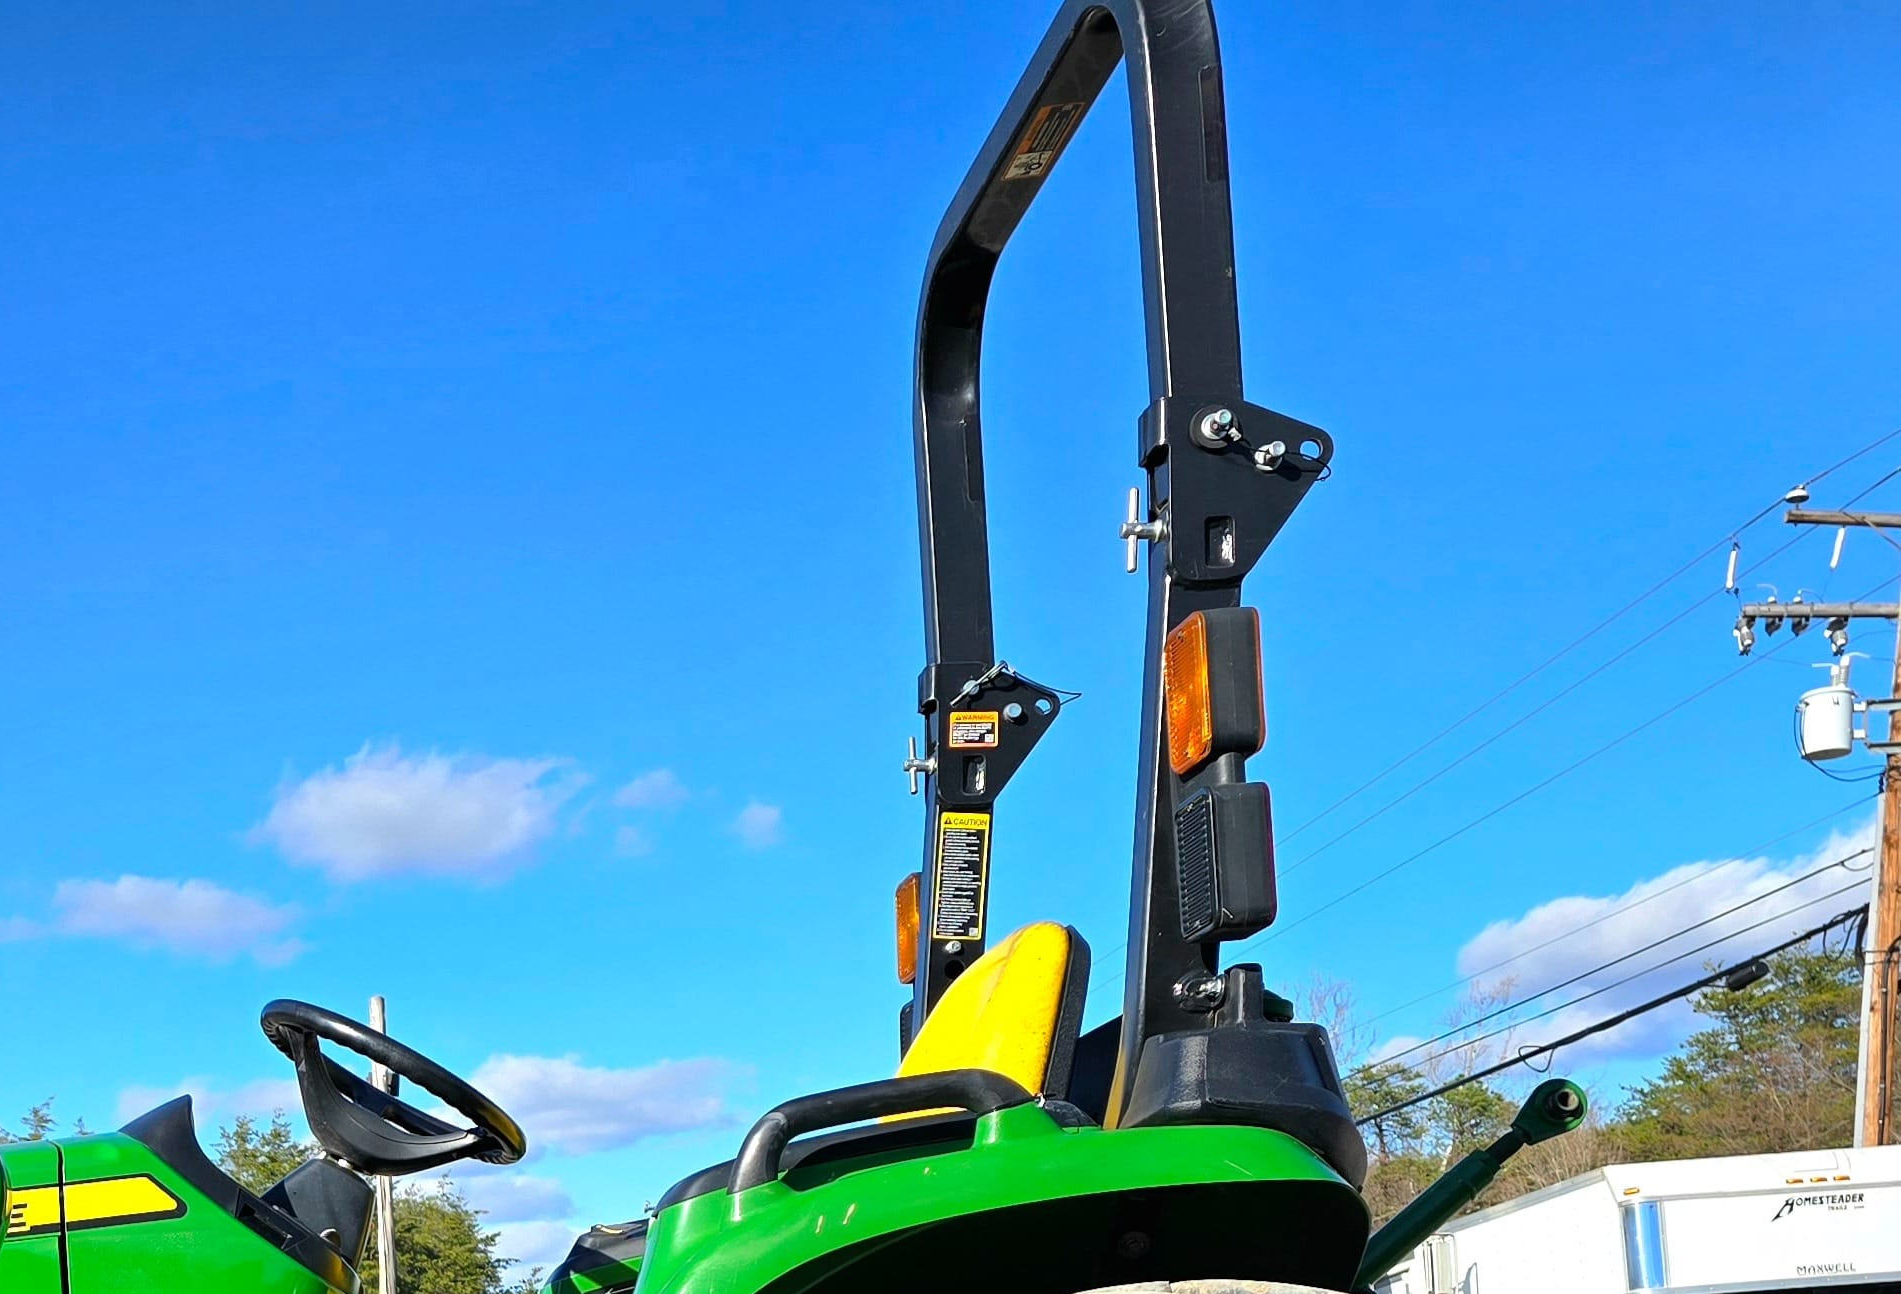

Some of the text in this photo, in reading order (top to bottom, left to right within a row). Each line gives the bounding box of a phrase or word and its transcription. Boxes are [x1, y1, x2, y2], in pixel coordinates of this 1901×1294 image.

[953, 816, 987, 827] CAUTION
[1771, 1193, 1865, 1222] HOMESTEADER
[1796, 1262, 1857, 1276] MAXWELL
